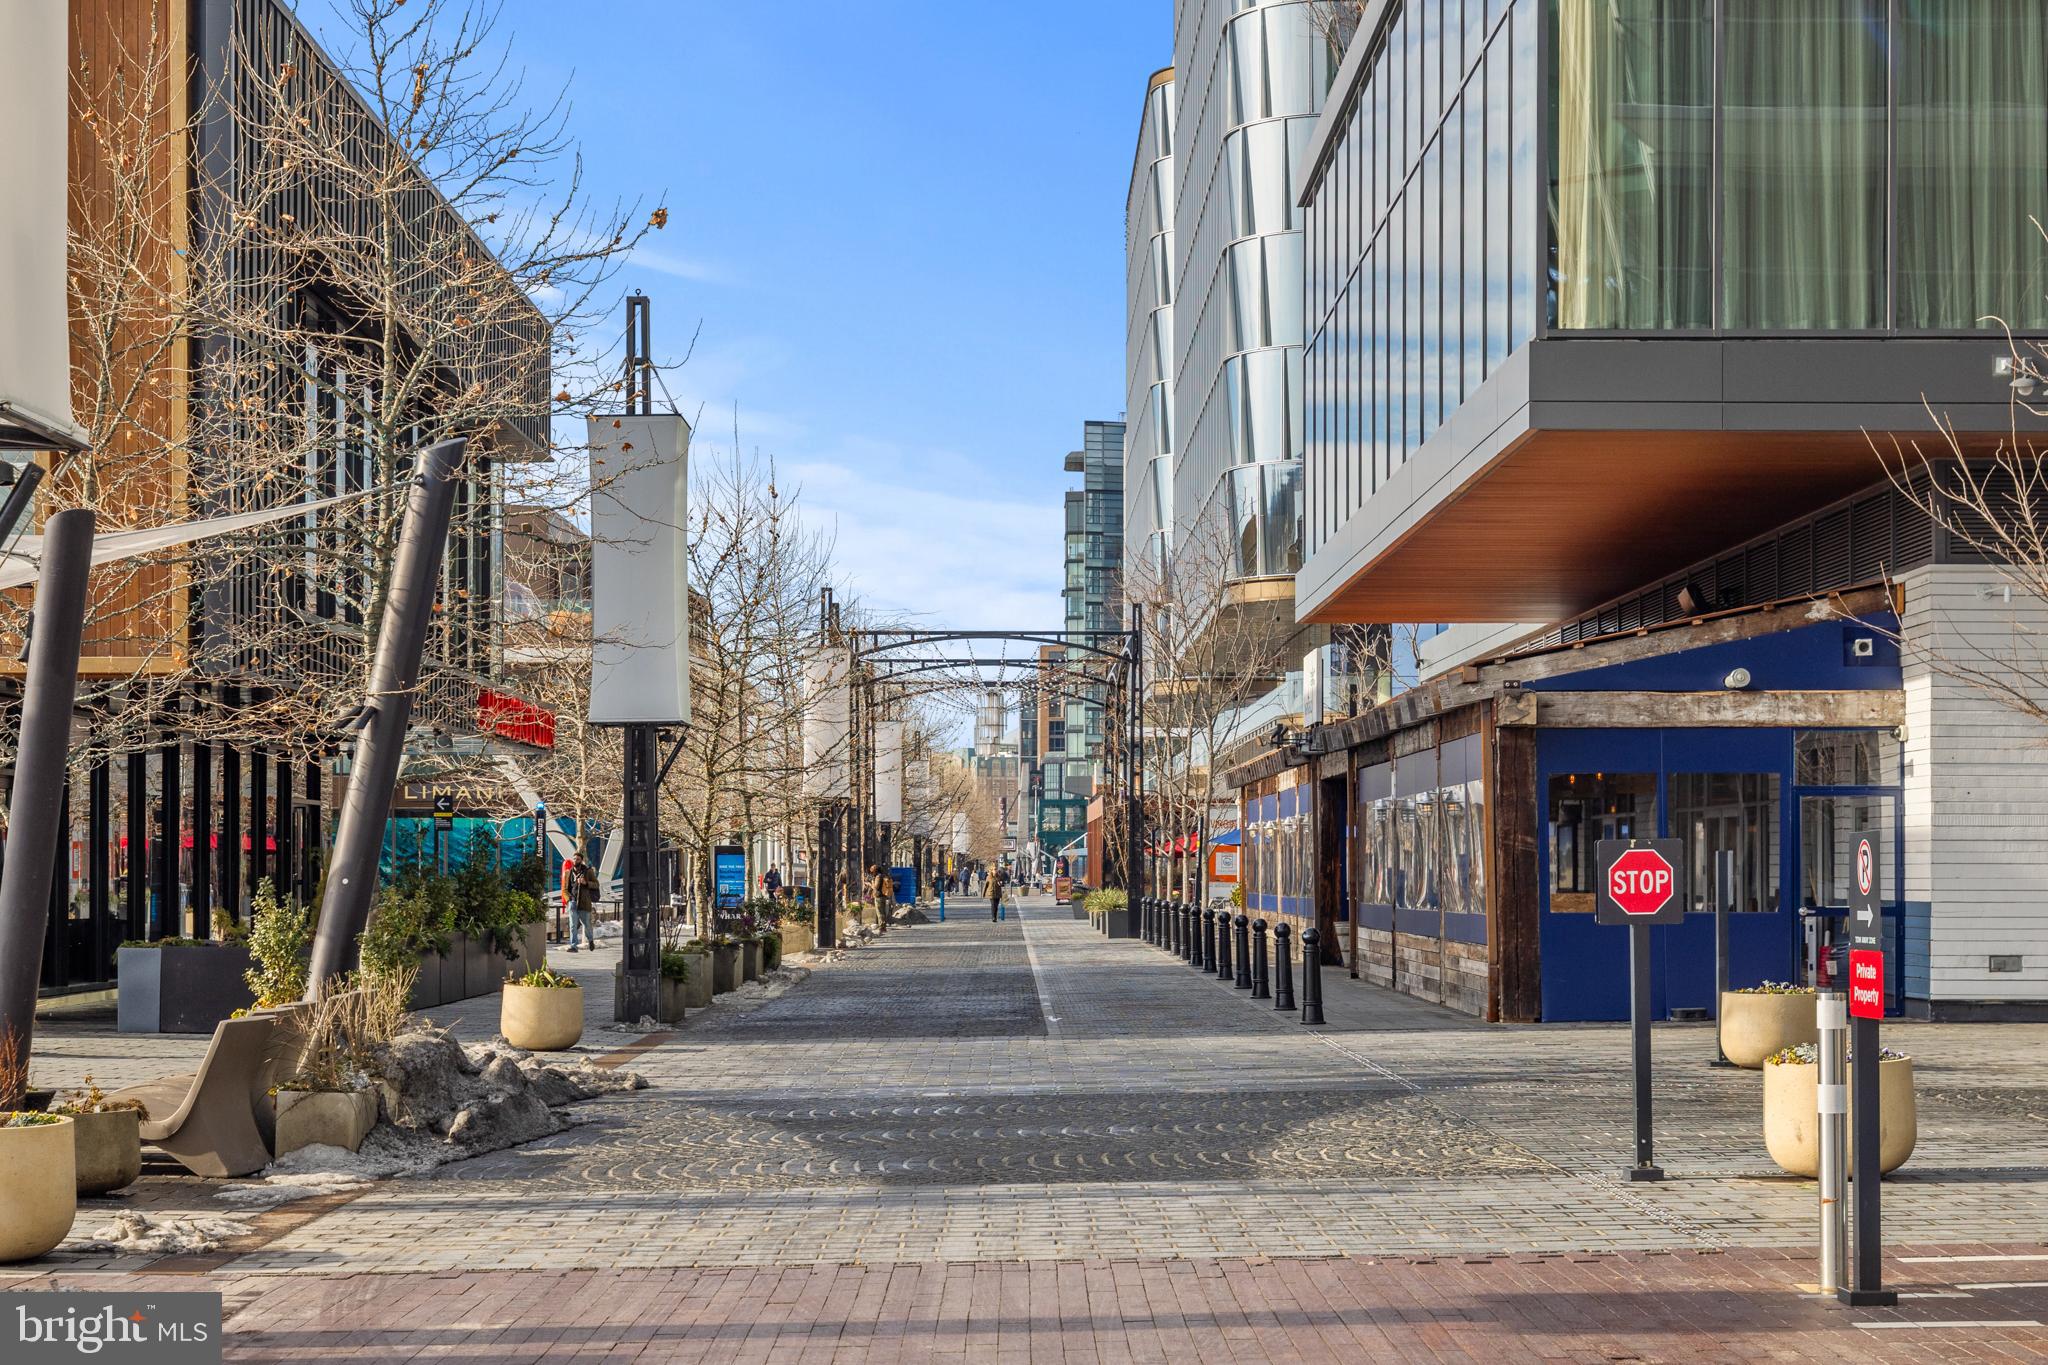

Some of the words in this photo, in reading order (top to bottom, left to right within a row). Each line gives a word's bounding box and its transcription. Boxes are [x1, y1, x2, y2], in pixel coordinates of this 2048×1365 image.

[404, 785, 503, 800] LIMANI
[536, 818, 545, 857] Emergency
[1613, 869, 1669, 895] STOP
[1856, 963, 1877, 980] Private
[1854, 986, 1880, 1006] Property
